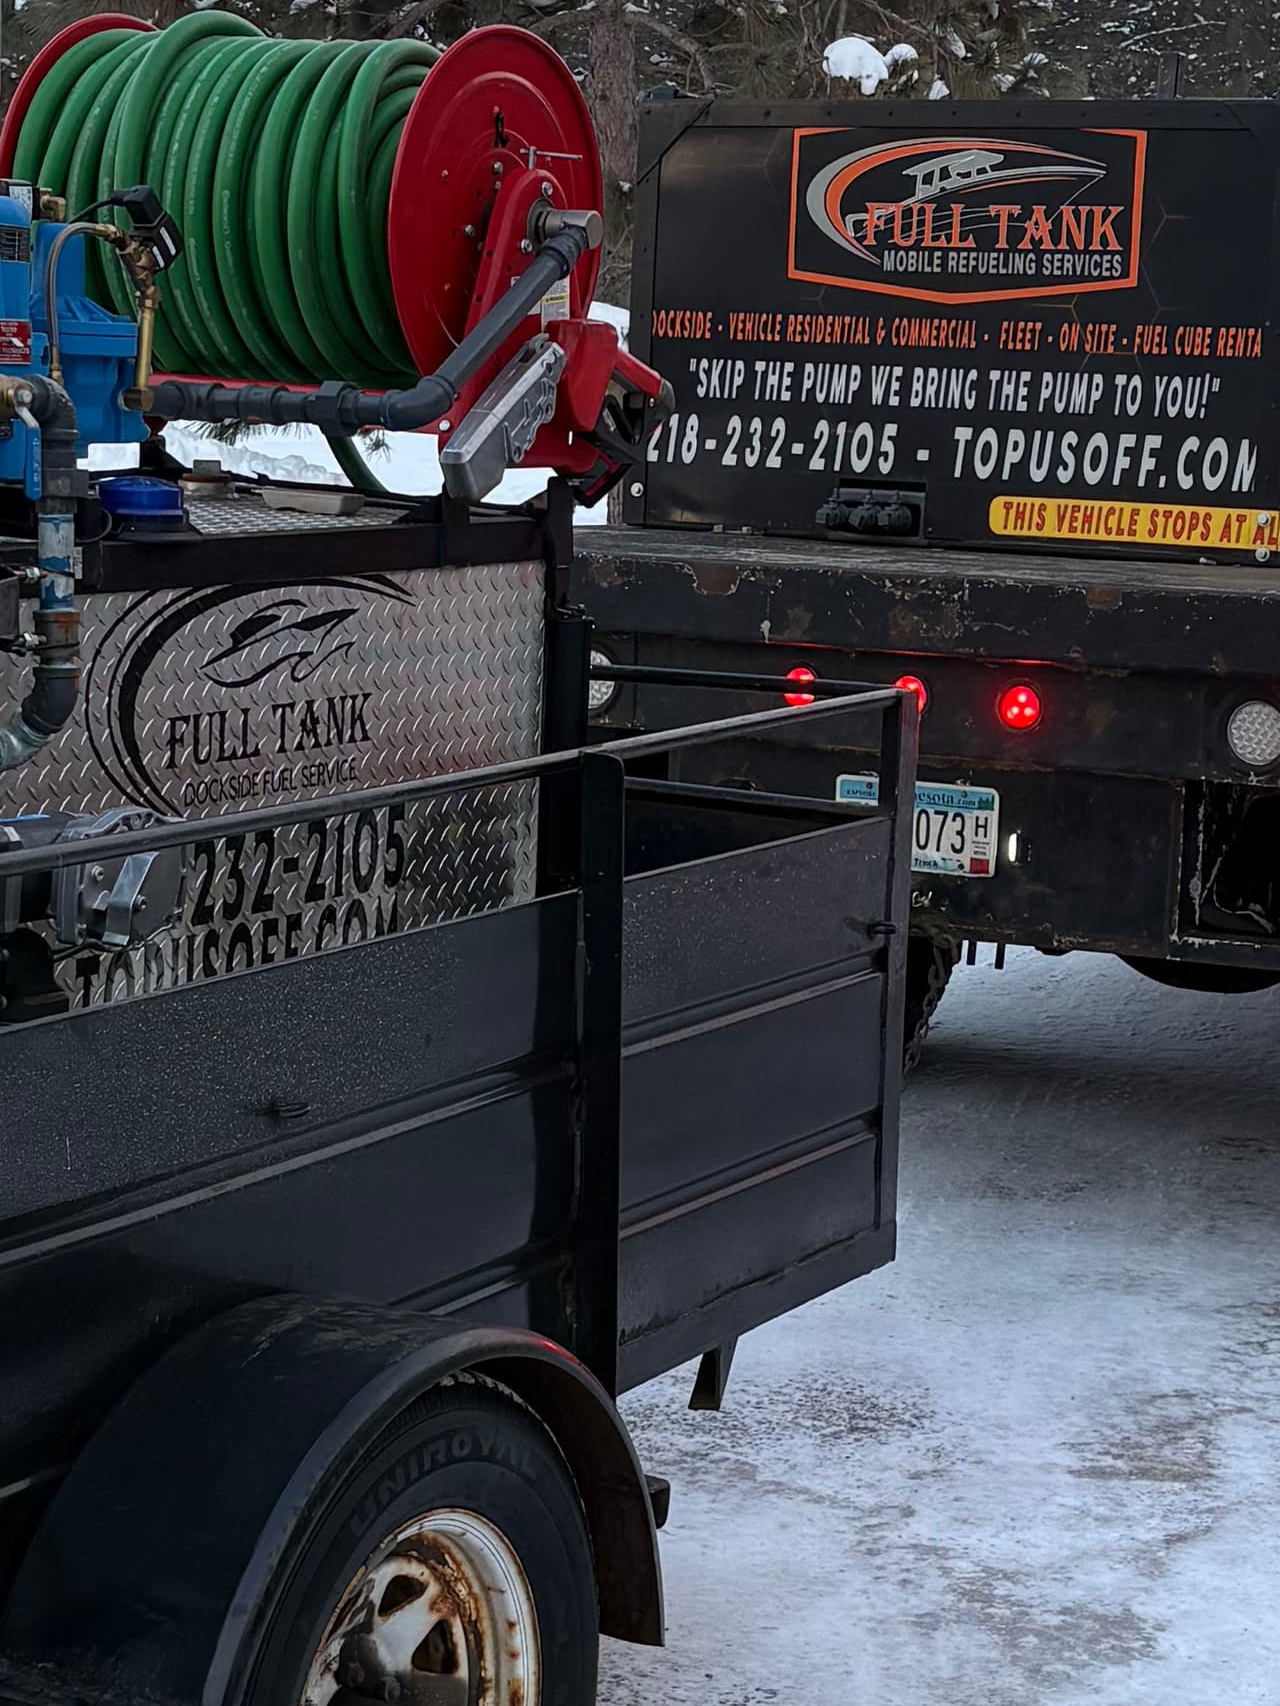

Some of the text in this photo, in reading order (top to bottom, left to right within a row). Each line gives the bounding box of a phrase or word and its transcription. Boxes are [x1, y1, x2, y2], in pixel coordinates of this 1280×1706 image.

[861, 201, 1125, 251] FULL TANK
[883, 250, 1122, 277] MOBILE REFUELING SERVICES
[728, 312, 781, 342] VEHICLE
[786, 314, 870, 344] RESIDENTIAL
[875, 317, 886, 345] &
[891, 318, 977, 349] COMMERCIAL
[999, 321, 1043, 351] FLEET
[1059, 323, 1081, 352] ON
[1084, 324, 1117, 354] SITE
[1133, 325, 1168, 355] FUEL
[1174, 326, 1211, 356] CUBE
[689, 358, 1220, 419] "SKIP THE PUMP WE BRING THE PUMP TO YOU!"
[646, 413, 898, 475] 218-232-2105
[953, 426, 1258, 493] TOPUSOFF.COM
[1003, 501, 1048, 532] THIS
[1056, 503, 1140, 537] VEHICLE
[1147, 508, 1212, 542] STOPS
[1219, 513, 1248, 544] AT
[165, 692, 373, 770] FULL TANK
[184, 757, 359, 807] DOCKSIDE FUEL SERVICE
[974, 816, 989, 839] H
[350, 1429, 537, 1533] UNIROYAL
